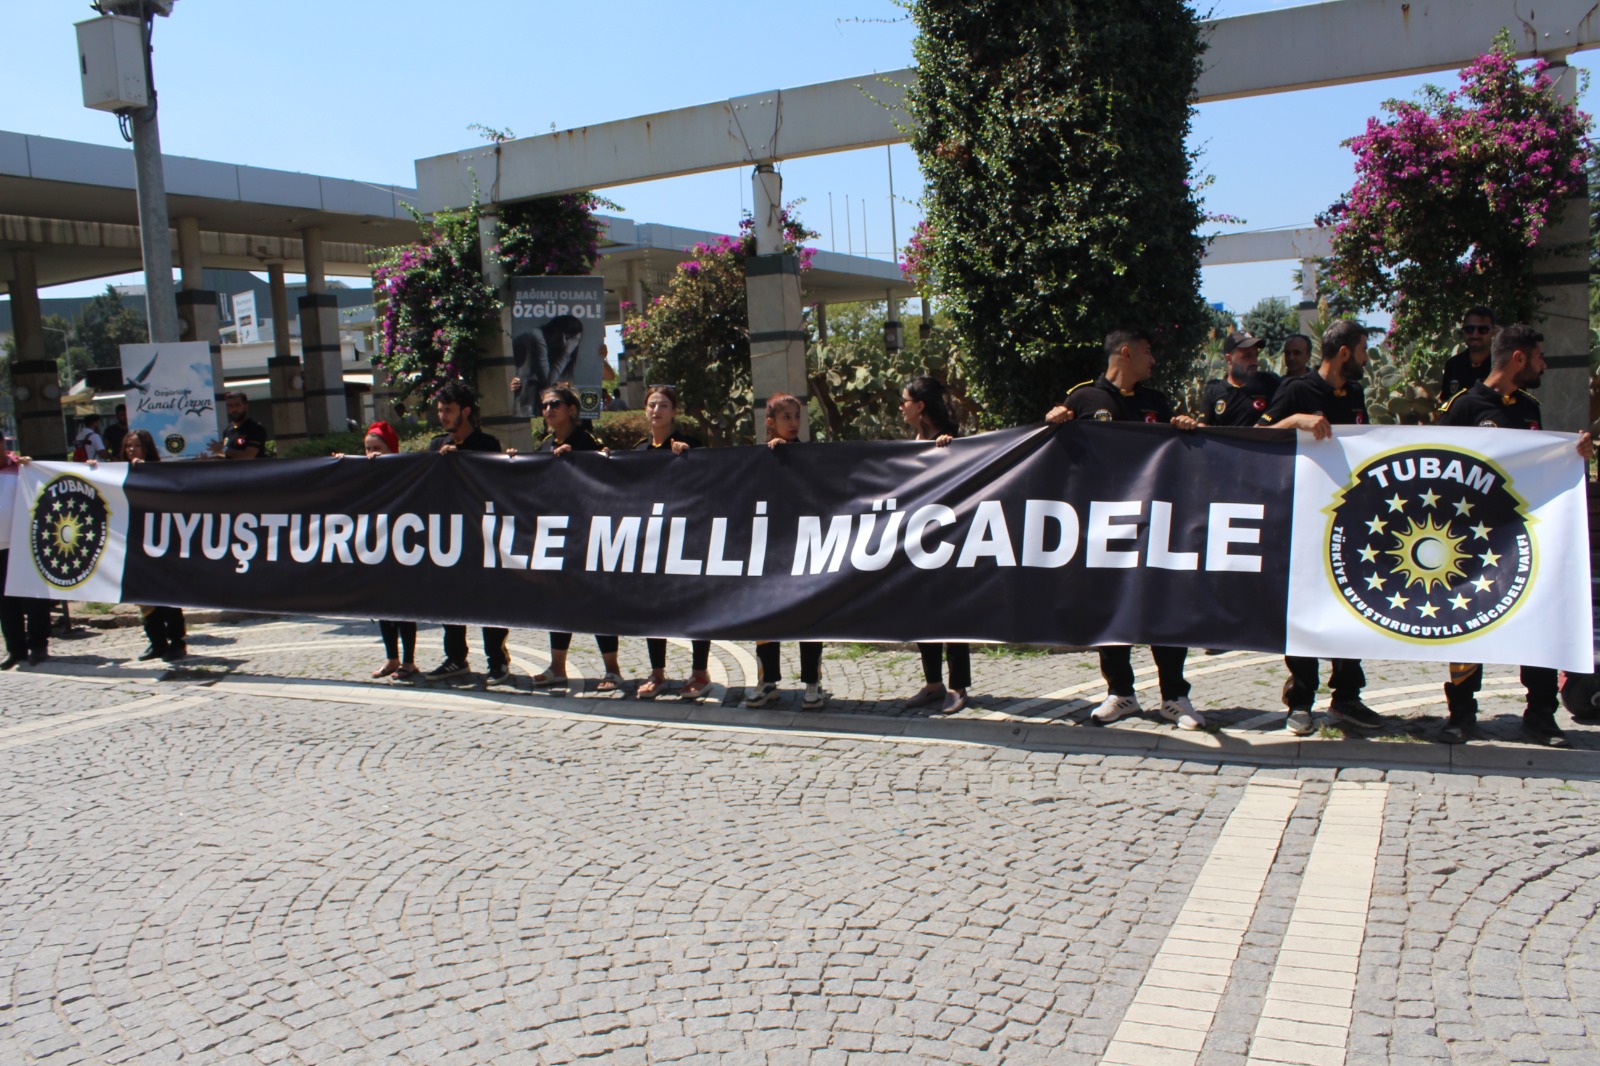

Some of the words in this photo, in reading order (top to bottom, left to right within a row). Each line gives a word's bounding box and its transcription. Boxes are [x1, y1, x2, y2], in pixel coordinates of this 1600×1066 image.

[516, 288, 558, 300] BAĞIMLI
[560, 290, 598, 301] OLMA!
[512, 300, 570, 318] ÖZGÜR
[571, 303, 602, 319] OL!
[136, 397, 176, 413] Kanat
[1367, 457, 1496, 495] TUBAM
[48, 479, 96, 500] TUBAM
[142, 512, 464, 574] UYUŞTURUCU
[482, 501, 569, 570] İLE
[585, 501, 768, 577] MİLLİ
[790, 498, 1265, 576] MÜCADELE
[1331, 526, 1349, 585] TÜRKİYE
[1343, 586, 1463, 636] UYUŞTURUCUYLA
[1465, 576, 1526, 630] MÜCADELE
[1516, 533, 1530, 573] VAKFI
